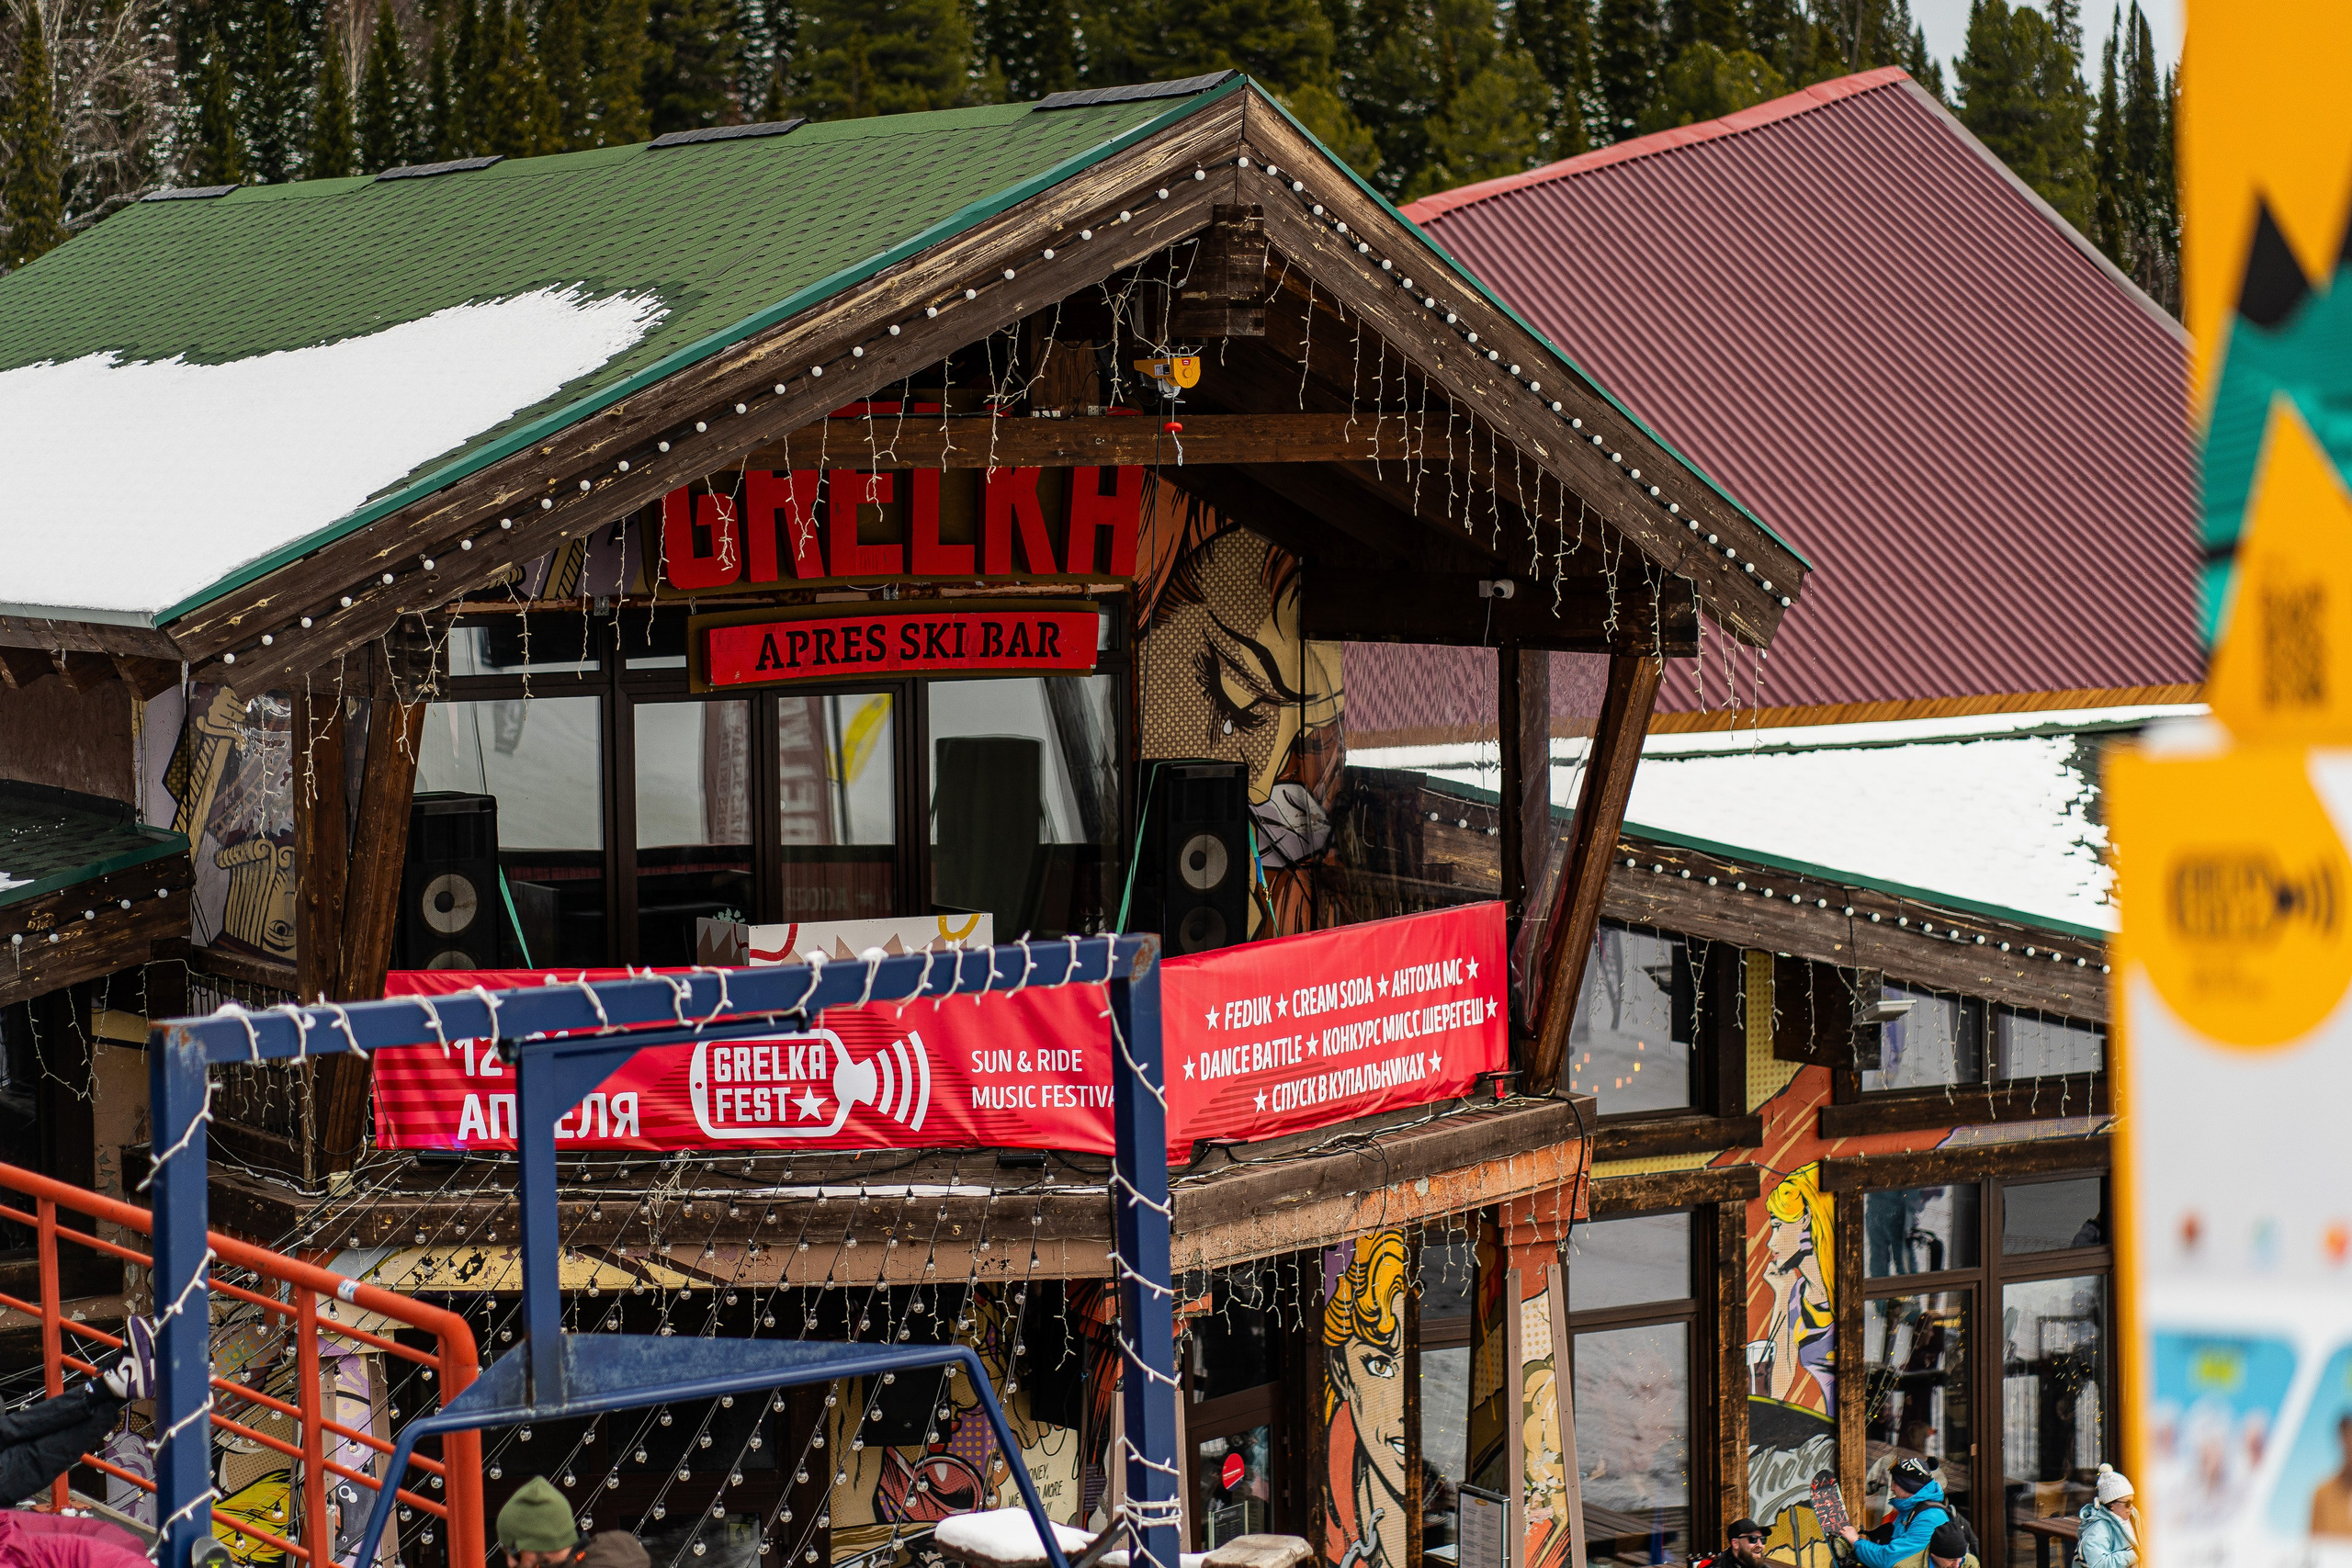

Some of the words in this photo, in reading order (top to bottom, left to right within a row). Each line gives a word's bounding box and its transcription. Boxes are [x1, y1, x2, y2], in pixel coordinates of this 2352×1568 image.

[655, 401, 1145, 591] GRELKA
[754, 623, 888, 672] APRES
[899, 622, 968, 661] SKI
[978, 621, 1063, 660] BAR
[1224, 995, 1273, 1032] FEDUK
[1292, 983, 1339, 1020] CREAM
[1339, 976, 1375, 1010] SODA
[1391, 962, 1442, 999] АНТОХА
[714, 1044, 827, 1082] GRELKA
[971, 1049, 1012, 1074] SUN
[1016, 1050, 1034, 1073] &
[1037, 1048, 1083, 1073] RIDE
[1200, 1045, 1250, 1082] DANCE
[1252, 1034, 1304, 1073] BATTLE
[1322, 1017, 1382, 1058] КОНКУРС
[1382, 1009, 1421, 1045] МИСС
[1421, 997, 1485, 1036] ШЕРЕГЕШ
[715, 1087, 791, 1122] FEST
[972, 1085, 1037, 1110] MUSIC
[1041, 1084, 1114, 1109] FESTIVA
[1272, 1077, 1317, 1114] СПУСК
[1317, 1074, 1329, 1104] В
[1329, 1052, 1426, 1101] КУПАЛЬНИКАХ
[457, 1091, 640, 1141] АПЛЯ
